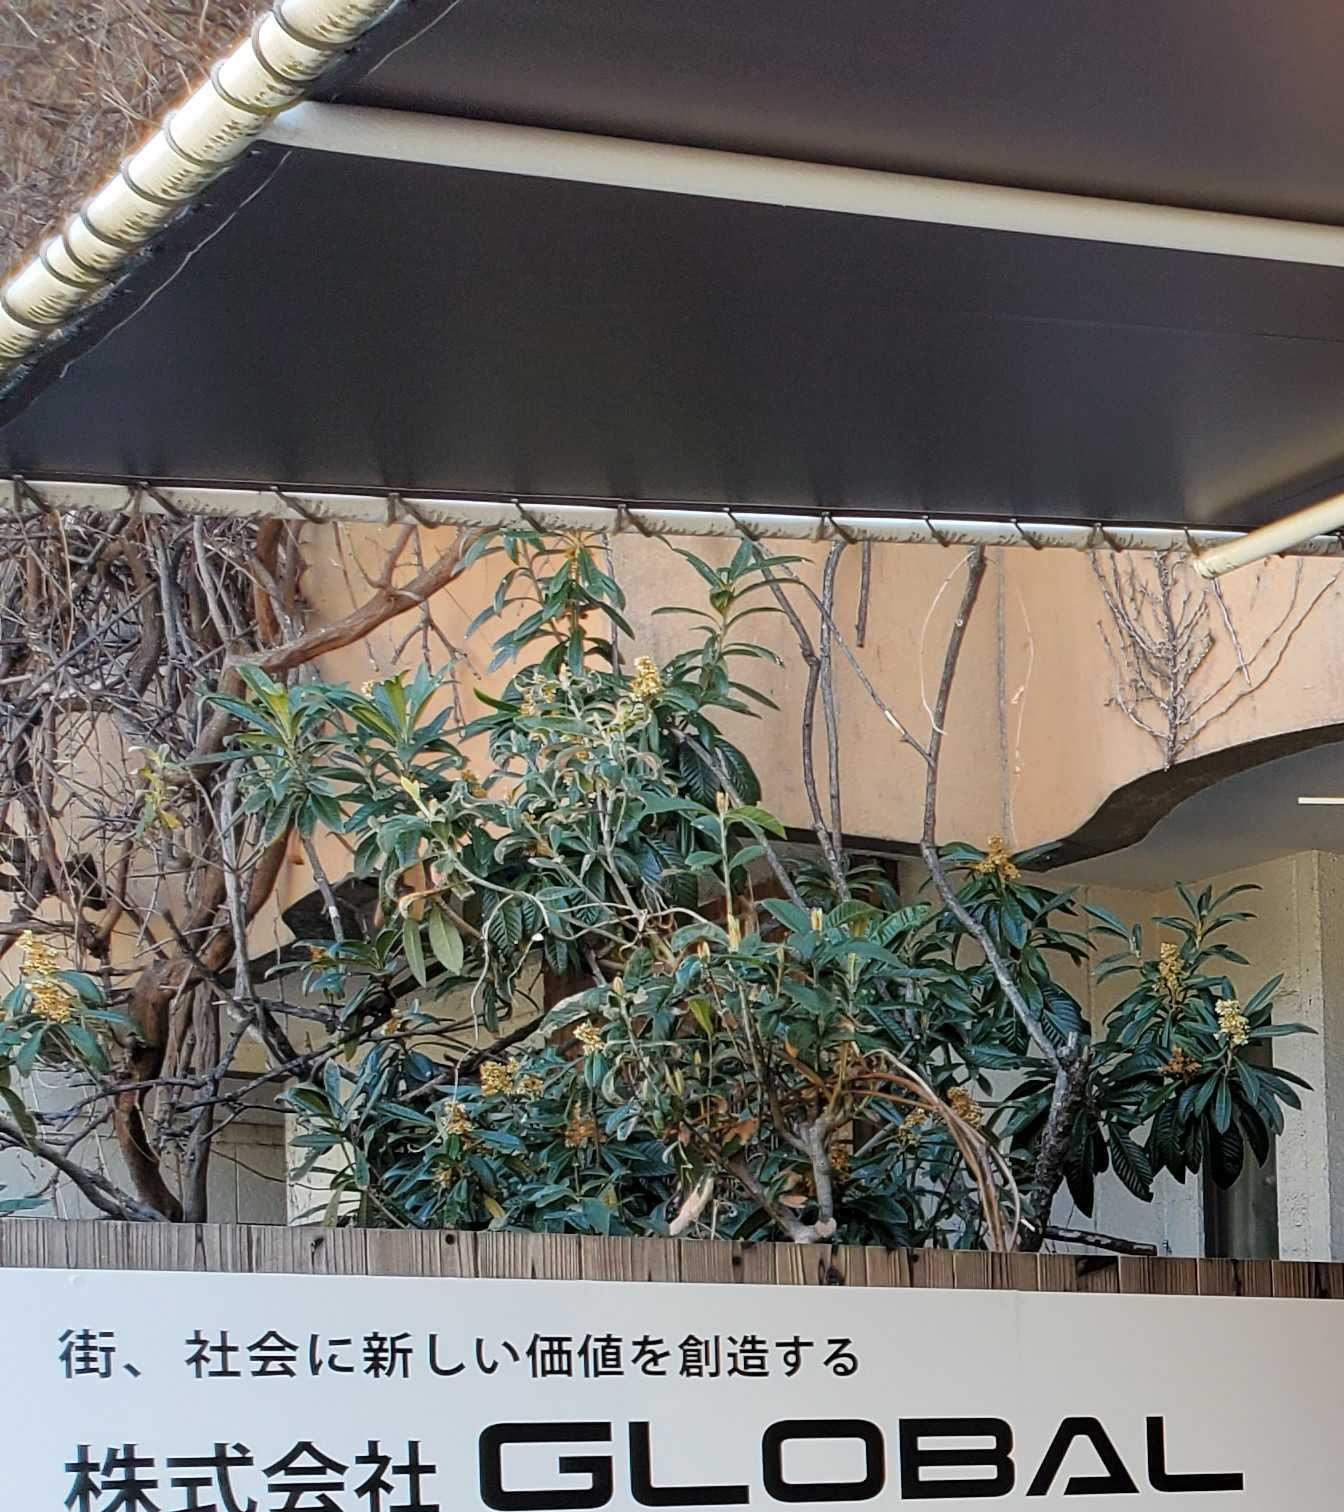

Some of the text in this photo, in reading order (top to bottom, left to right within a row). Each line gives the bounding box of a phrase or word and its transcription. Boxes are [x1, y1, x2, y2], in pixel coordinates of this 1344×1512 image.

[57, 1327, 862, 1381] 街、社会に新しい価値を創造する
[478, 1415, 1245, 1512] GLOBAL
